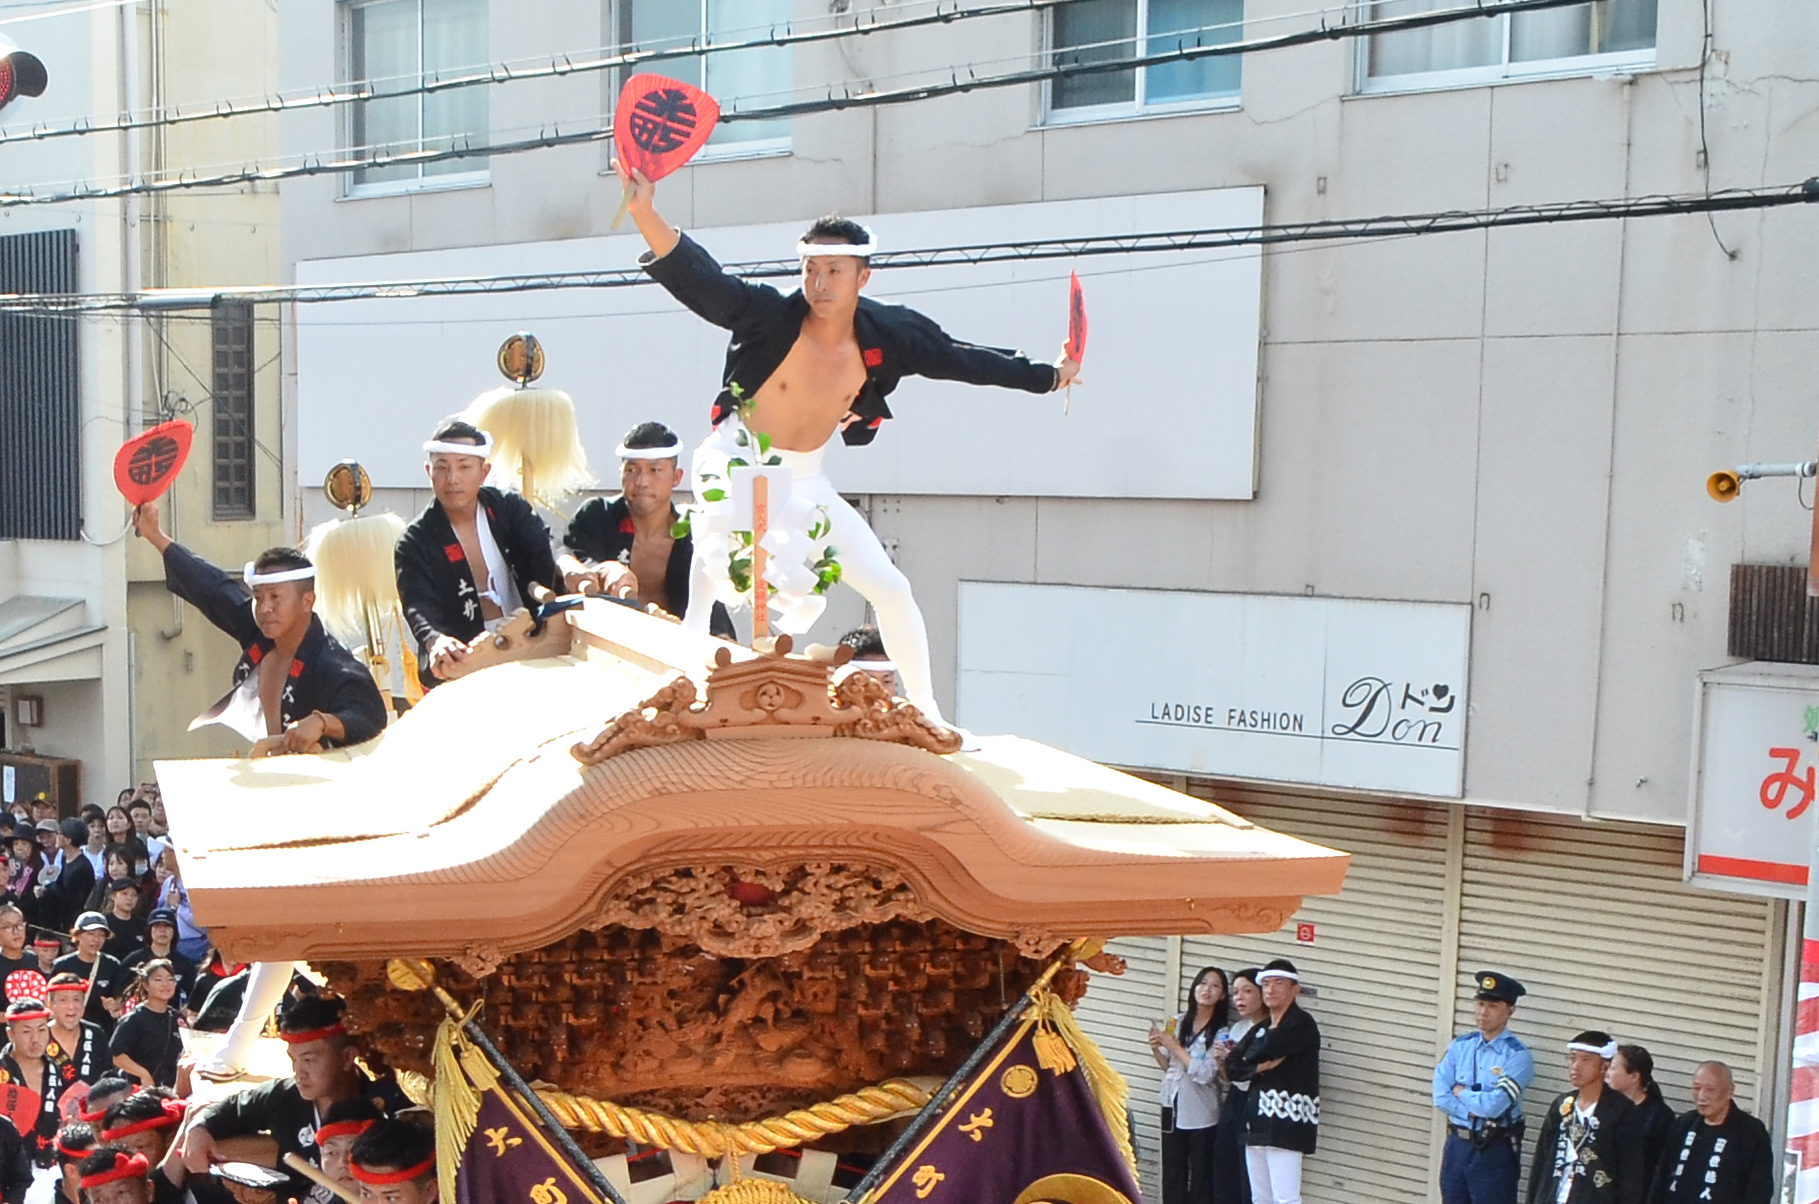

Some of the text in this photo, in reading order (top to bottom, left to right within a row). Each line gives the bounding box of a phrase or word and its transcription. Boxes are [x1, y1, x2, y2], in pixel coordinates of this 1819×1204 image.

[1151, 702, 1304, 733] LADISE FASHION
[1331, 676, 1444, 744] Don
[1759, 747, 1816, 820] み
[912, 1107, 994, 1199] 大町
